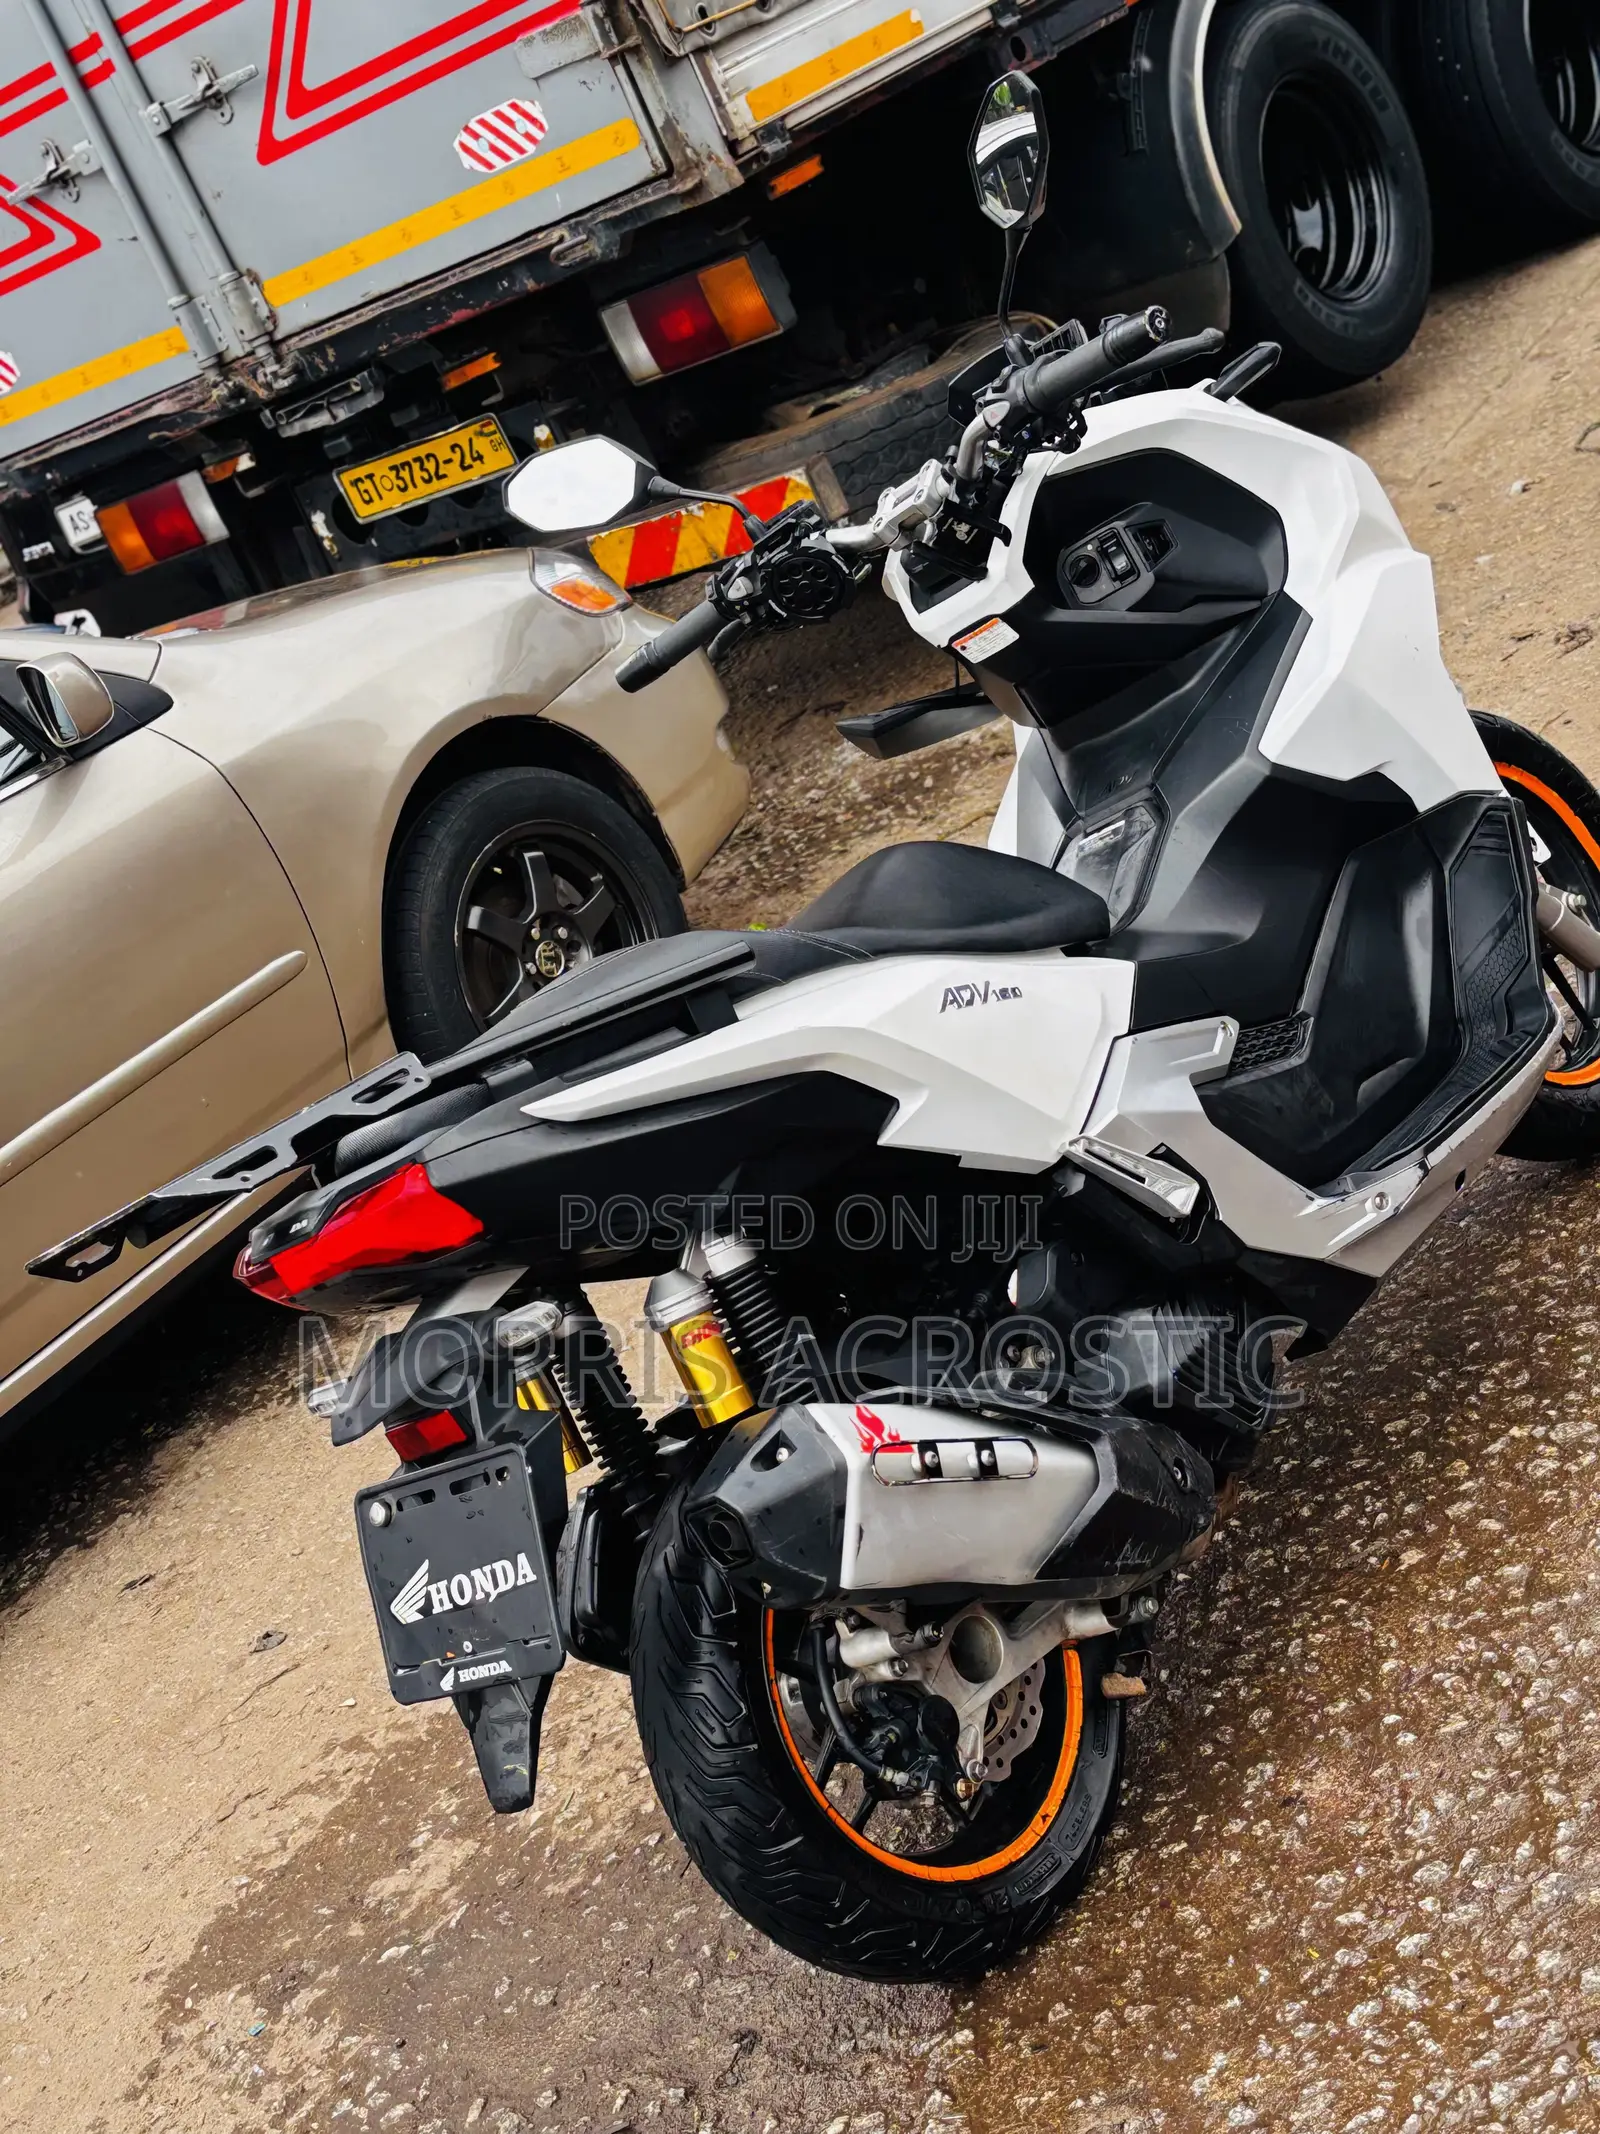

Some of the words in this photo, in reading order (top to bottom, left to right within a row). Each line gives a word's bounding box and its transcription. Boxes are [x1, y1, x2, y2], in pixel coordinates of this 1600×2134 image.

[388, 437, 485, 493] 3732-24
[427, 1552, 538, 1615] HONDA
[457, 1659, 513, 1683] HONDA
